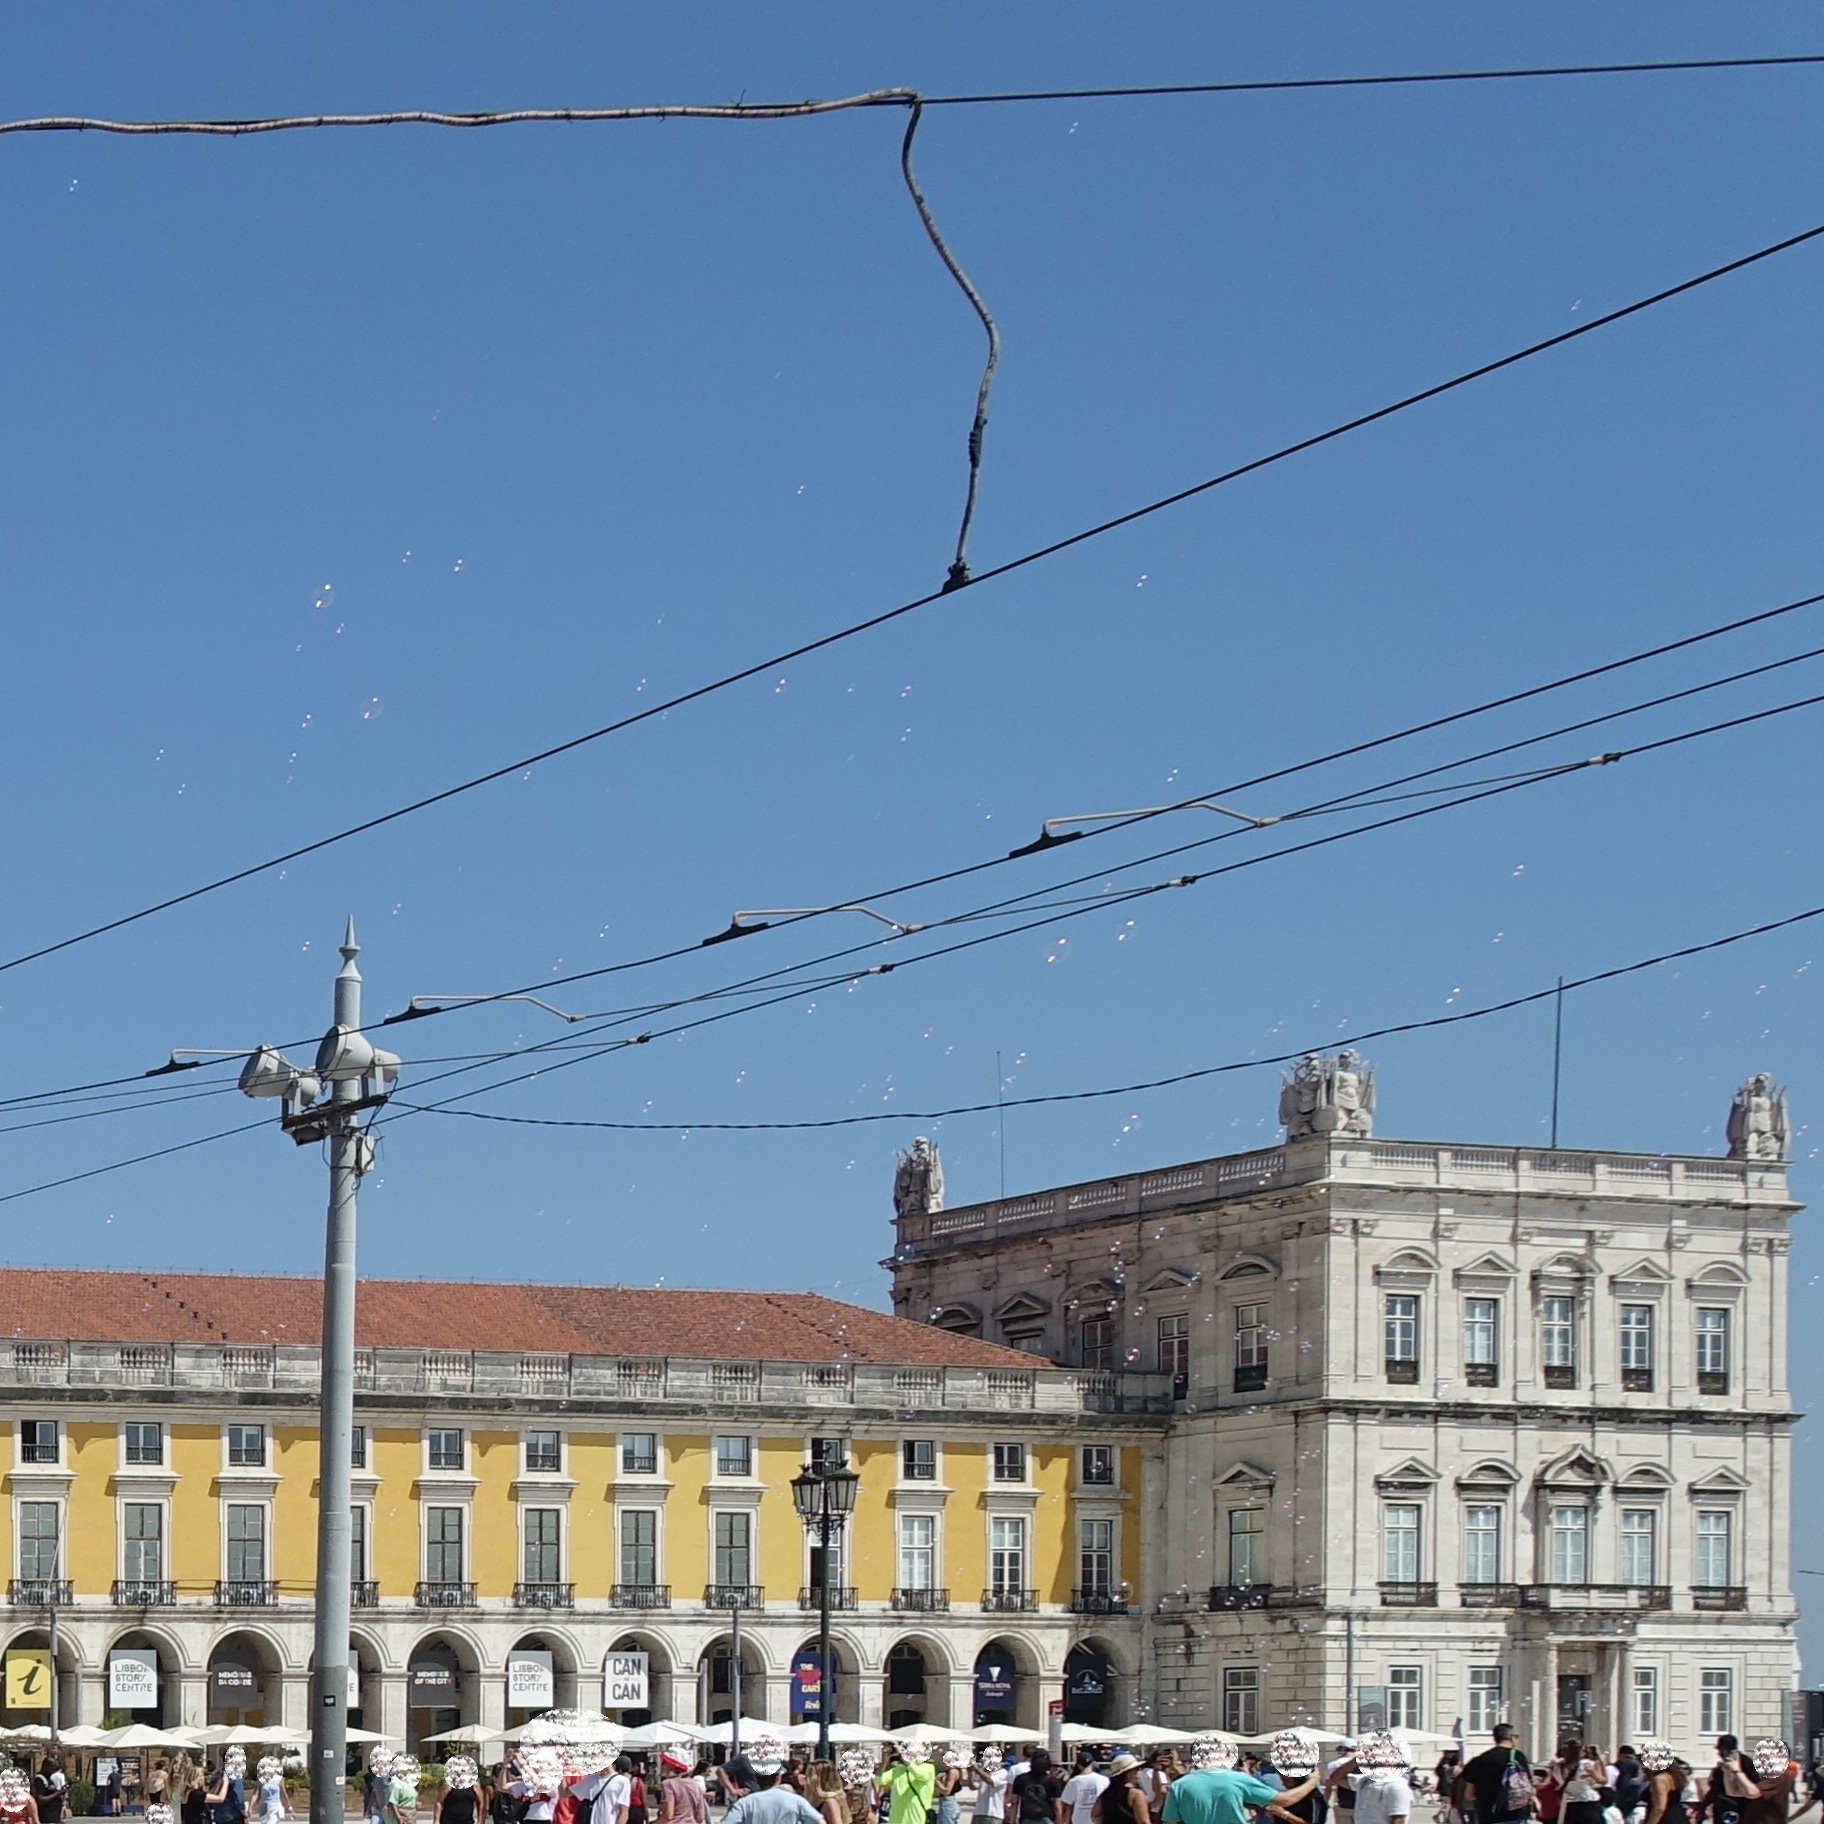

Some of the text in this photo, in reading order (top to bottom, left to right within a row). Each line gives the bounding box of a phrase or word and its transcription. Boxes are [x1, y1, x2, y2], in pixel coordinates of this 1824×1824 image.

[512, 1664, 544, 1673] LISBO
[612, 1657, 642, 1676] CAN
[114, 1683, 153, 1692] CENTRE
[612, 1683, 642, 1701] CAN
